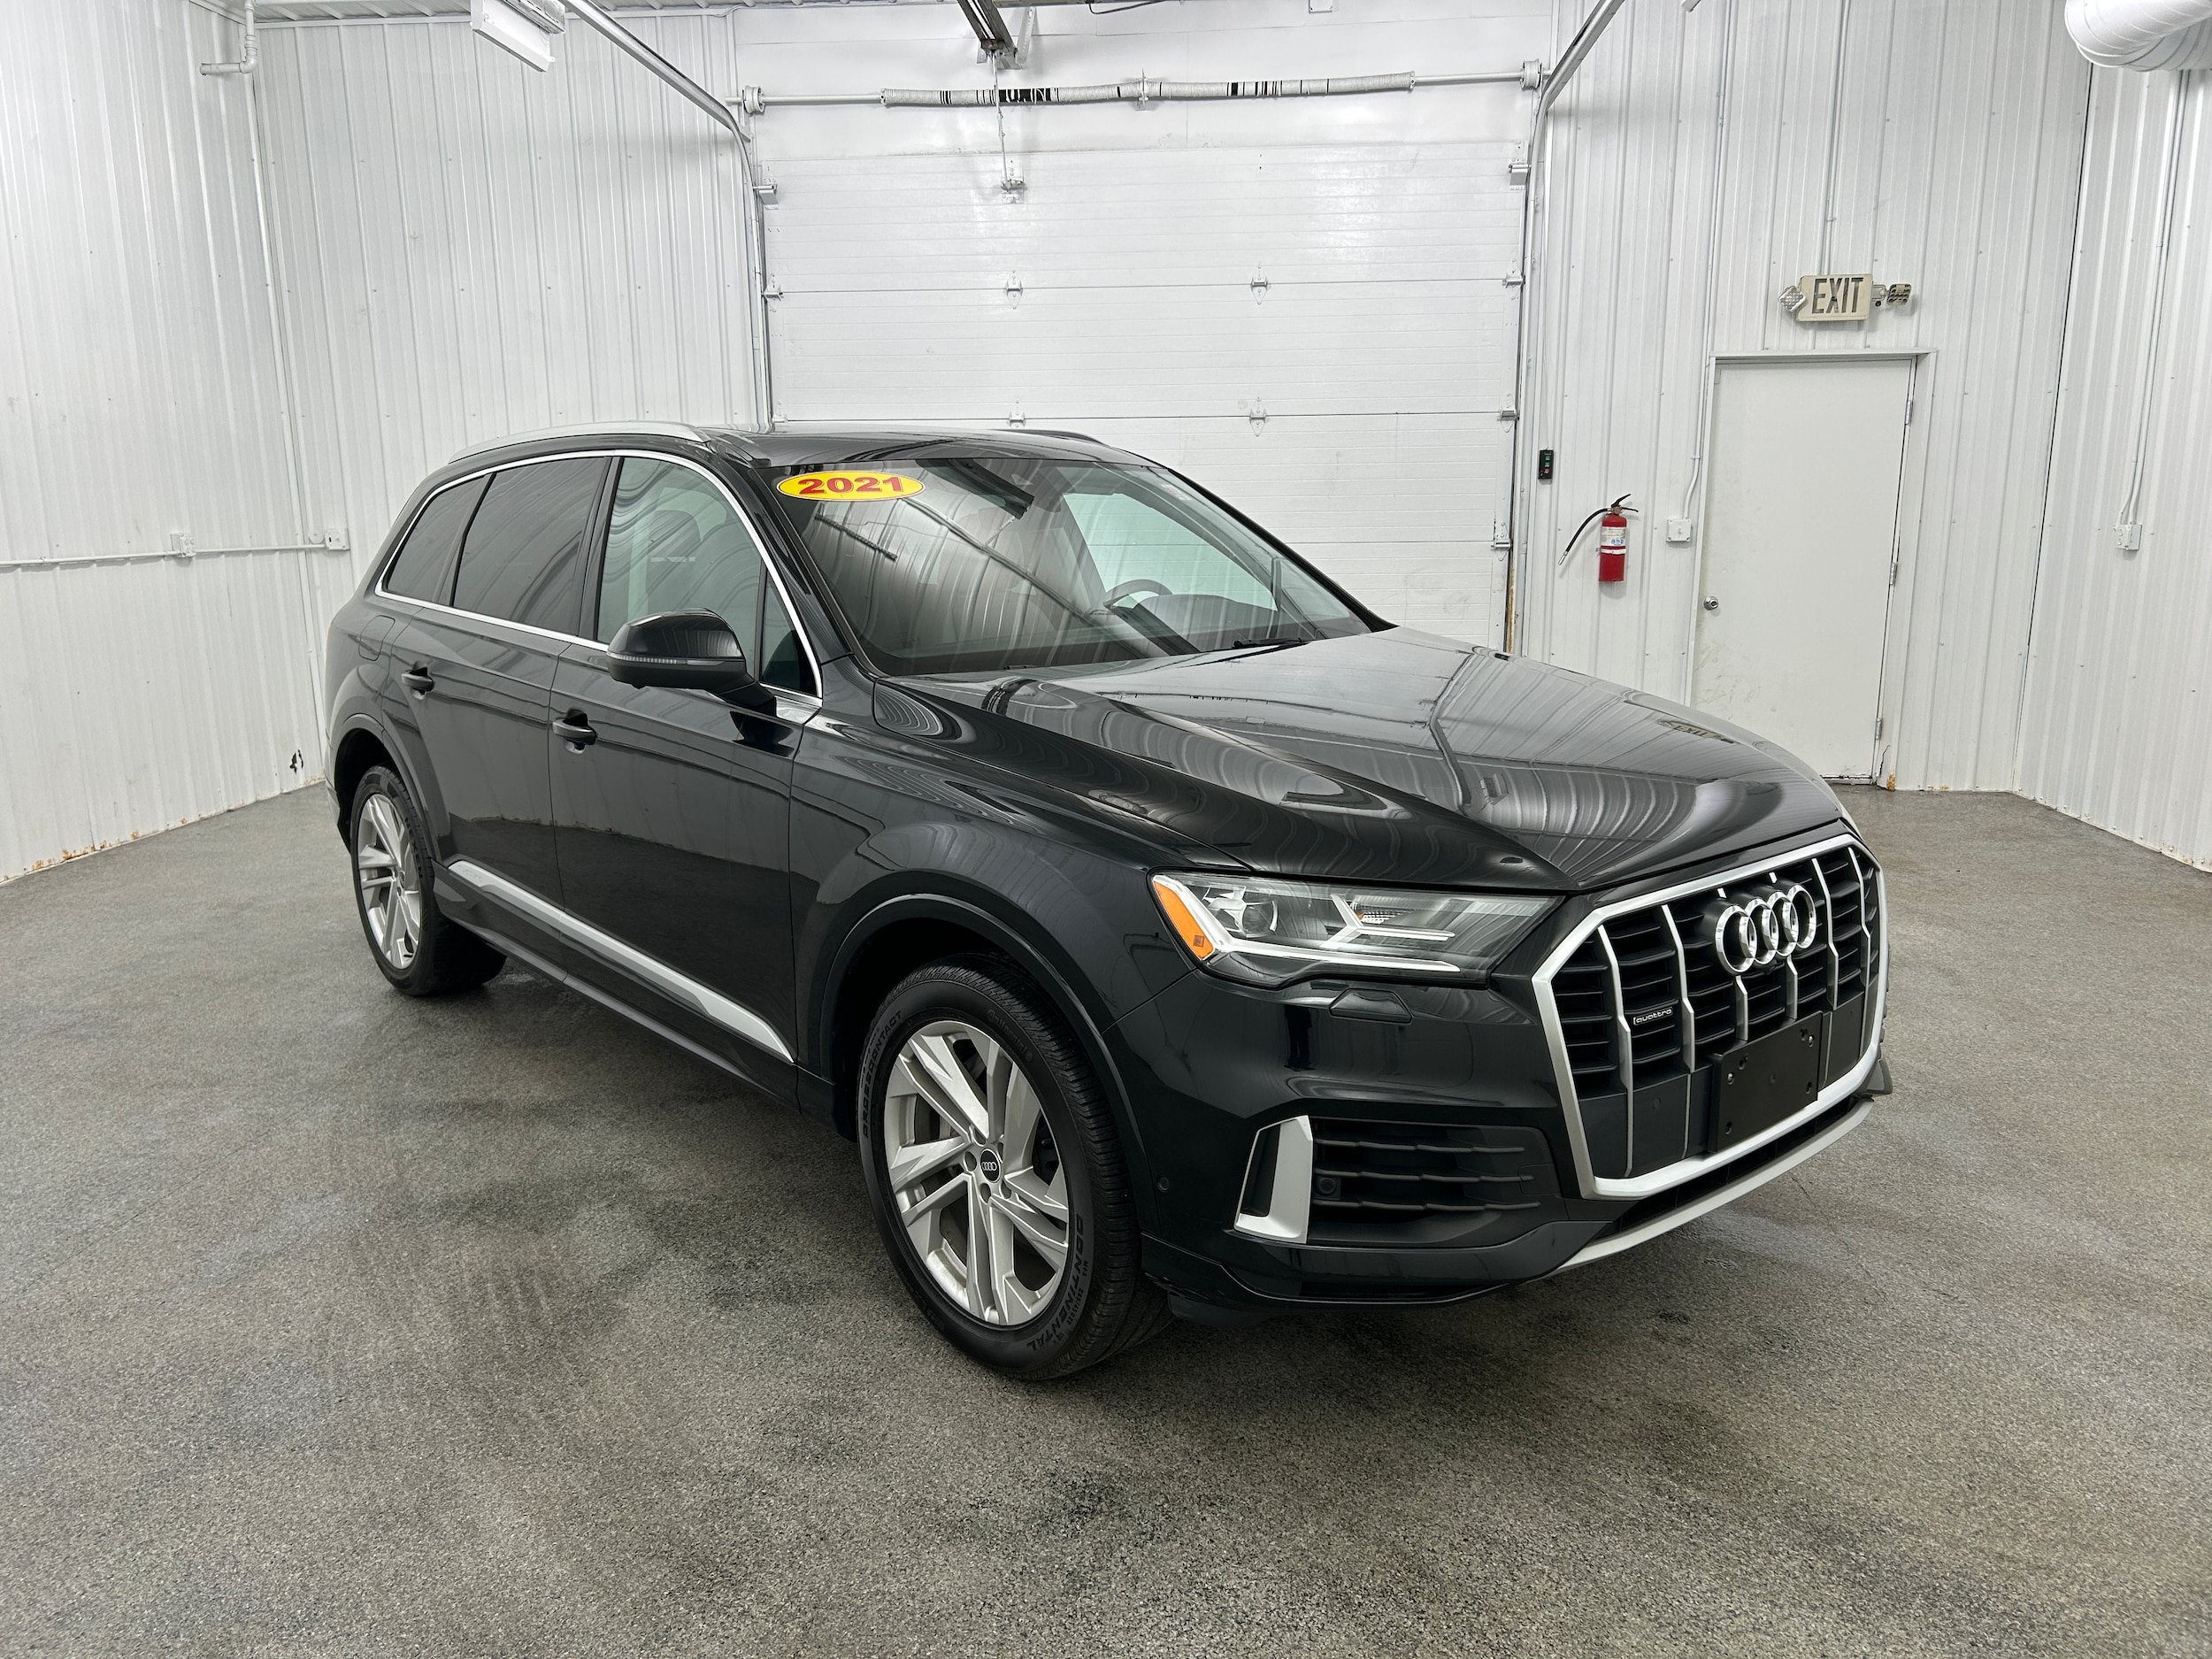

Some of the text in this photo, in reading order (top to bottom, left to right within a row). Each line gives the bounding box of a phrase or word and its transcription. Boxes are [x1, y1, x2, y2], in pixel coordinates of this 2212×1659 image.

[1811, 277, 1864, 314] EXIT
[798, 476, 904, 495] 2021
[1635, 1008, 1672, 1024] quattro
